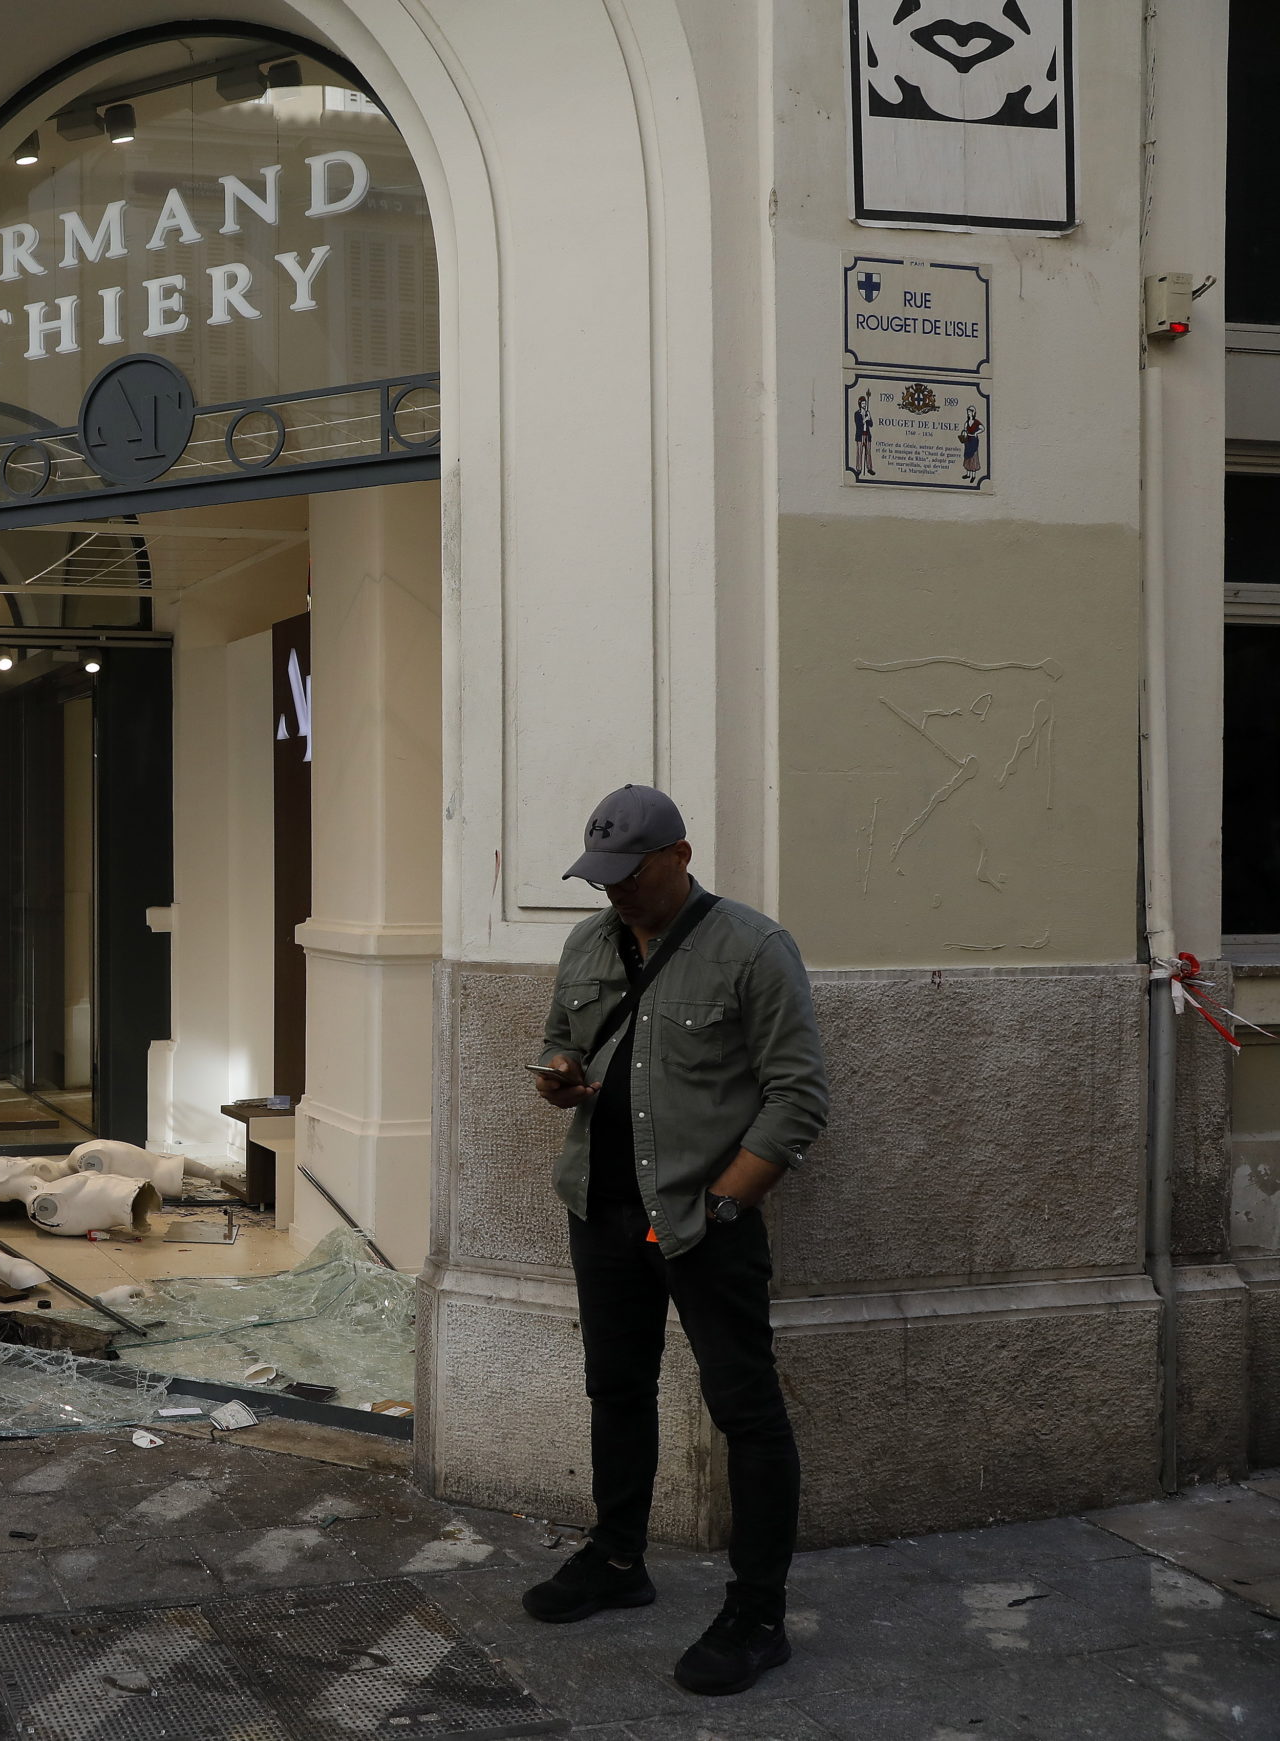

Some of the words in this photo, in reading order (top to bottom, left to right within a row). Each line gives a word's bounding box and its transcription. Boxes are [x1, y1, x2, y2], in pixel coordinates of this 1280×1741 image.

[903, 291, 932, 309] RUE
[856, 313, 918, 334] ROUGET
[922, 318, 941, 336] DE
[944, 320, 979, 338] L'ISLE
[879, 393, 894, 402] 1789
[944, 397, 959, 407] 1989
[878, 417, 915, 428] ROUGET
[918, 420, 930, 429] DE
[932, 421, 960, 431] L'ISLE
